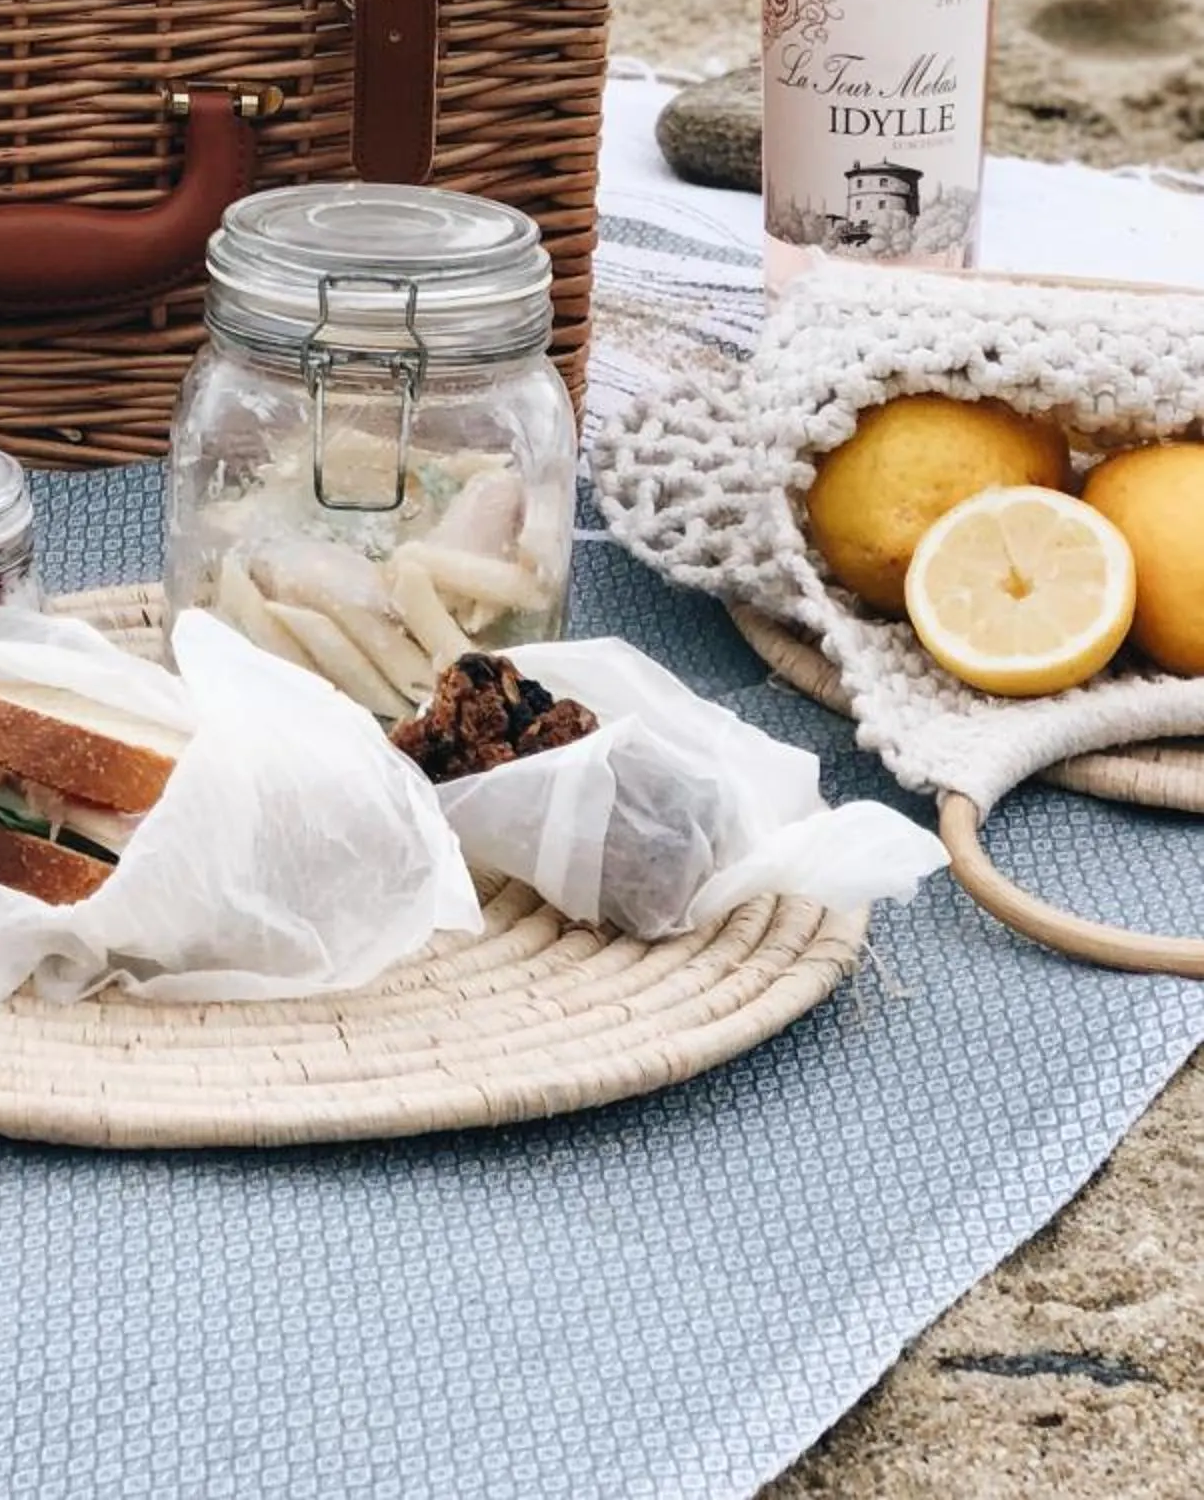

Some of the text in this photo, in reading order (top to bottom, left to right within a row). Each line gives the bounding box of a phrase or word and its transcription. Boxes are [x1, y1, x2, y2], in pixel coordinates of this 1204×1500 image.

[776, 43, 957, 98] La Tour Melas
[827, 102, 957, 137] IDYLLE
